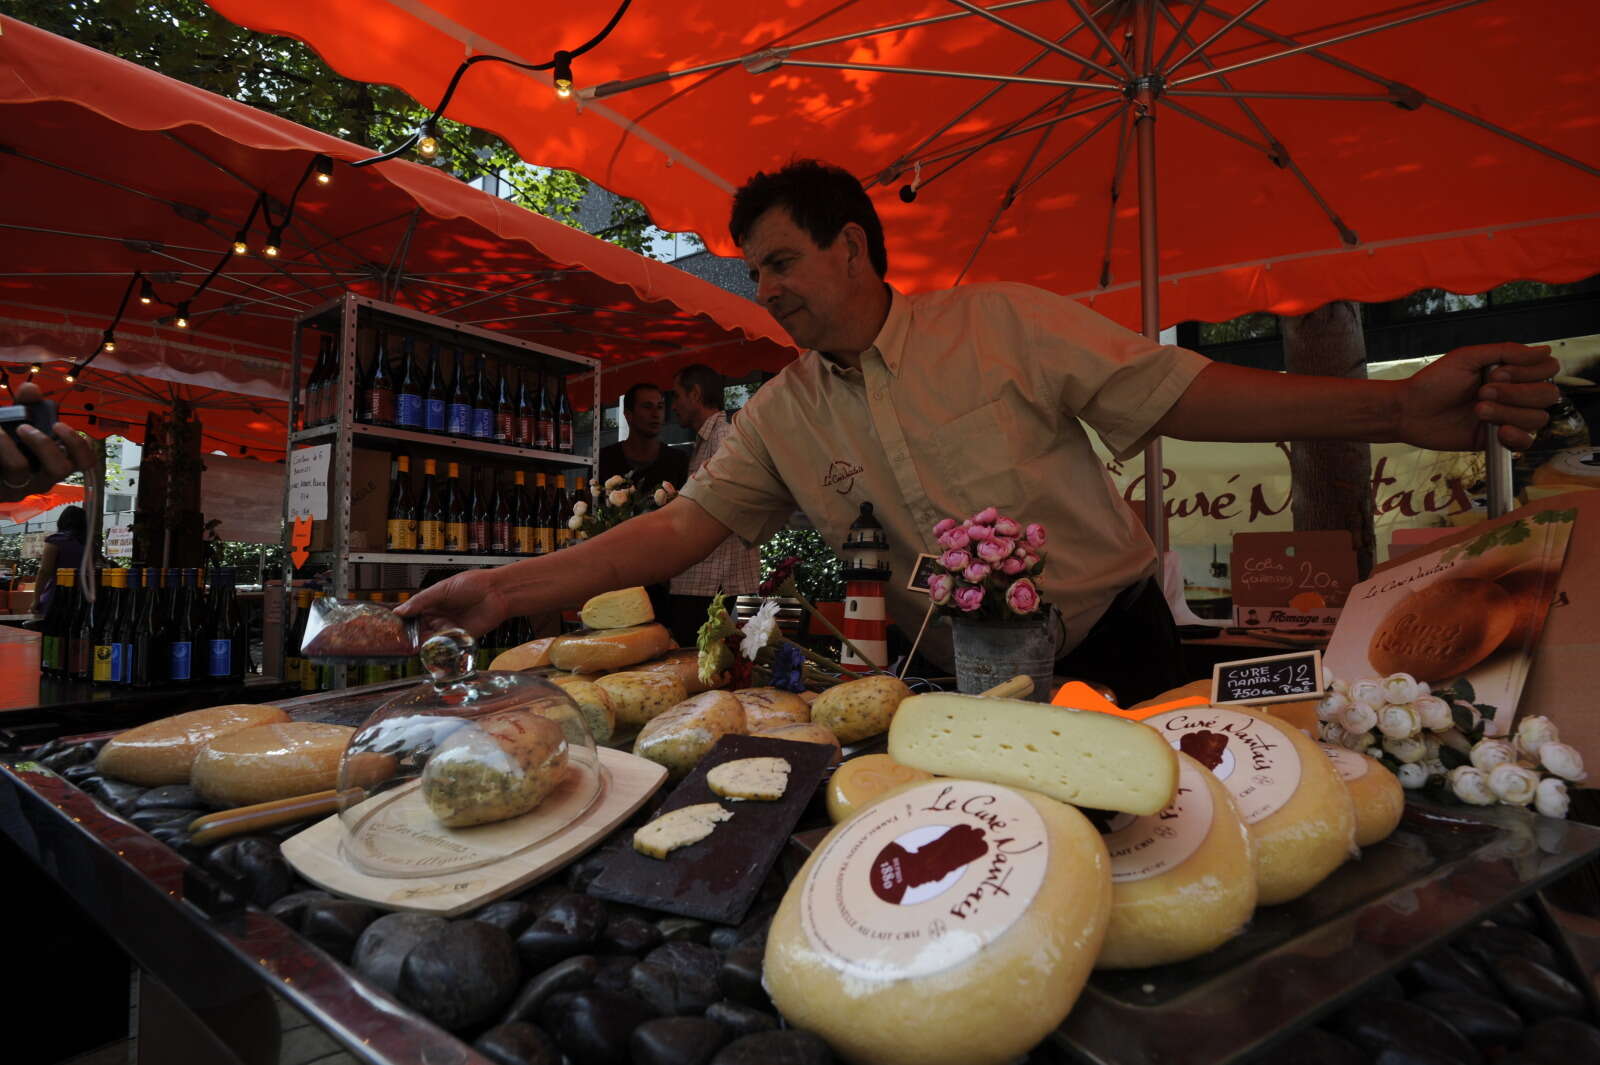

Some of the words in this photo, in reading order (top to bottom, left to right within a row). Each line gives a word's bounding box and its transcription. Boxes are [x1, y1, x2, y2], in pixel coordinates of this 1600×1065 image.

[1249, 441, 1473, 523] Ntais
[1268, 610, 1319, 626] Fromage
[1227, 666, 1271, 681] CURE
[1165, 715, 1220, 732] Curé
[1219, 718, 1279, 771] Nantais
[920, 785, 956, 812] Le
[961, 795, 1018, 833] Curé
[949, 838, 1043, 919] Nantais
